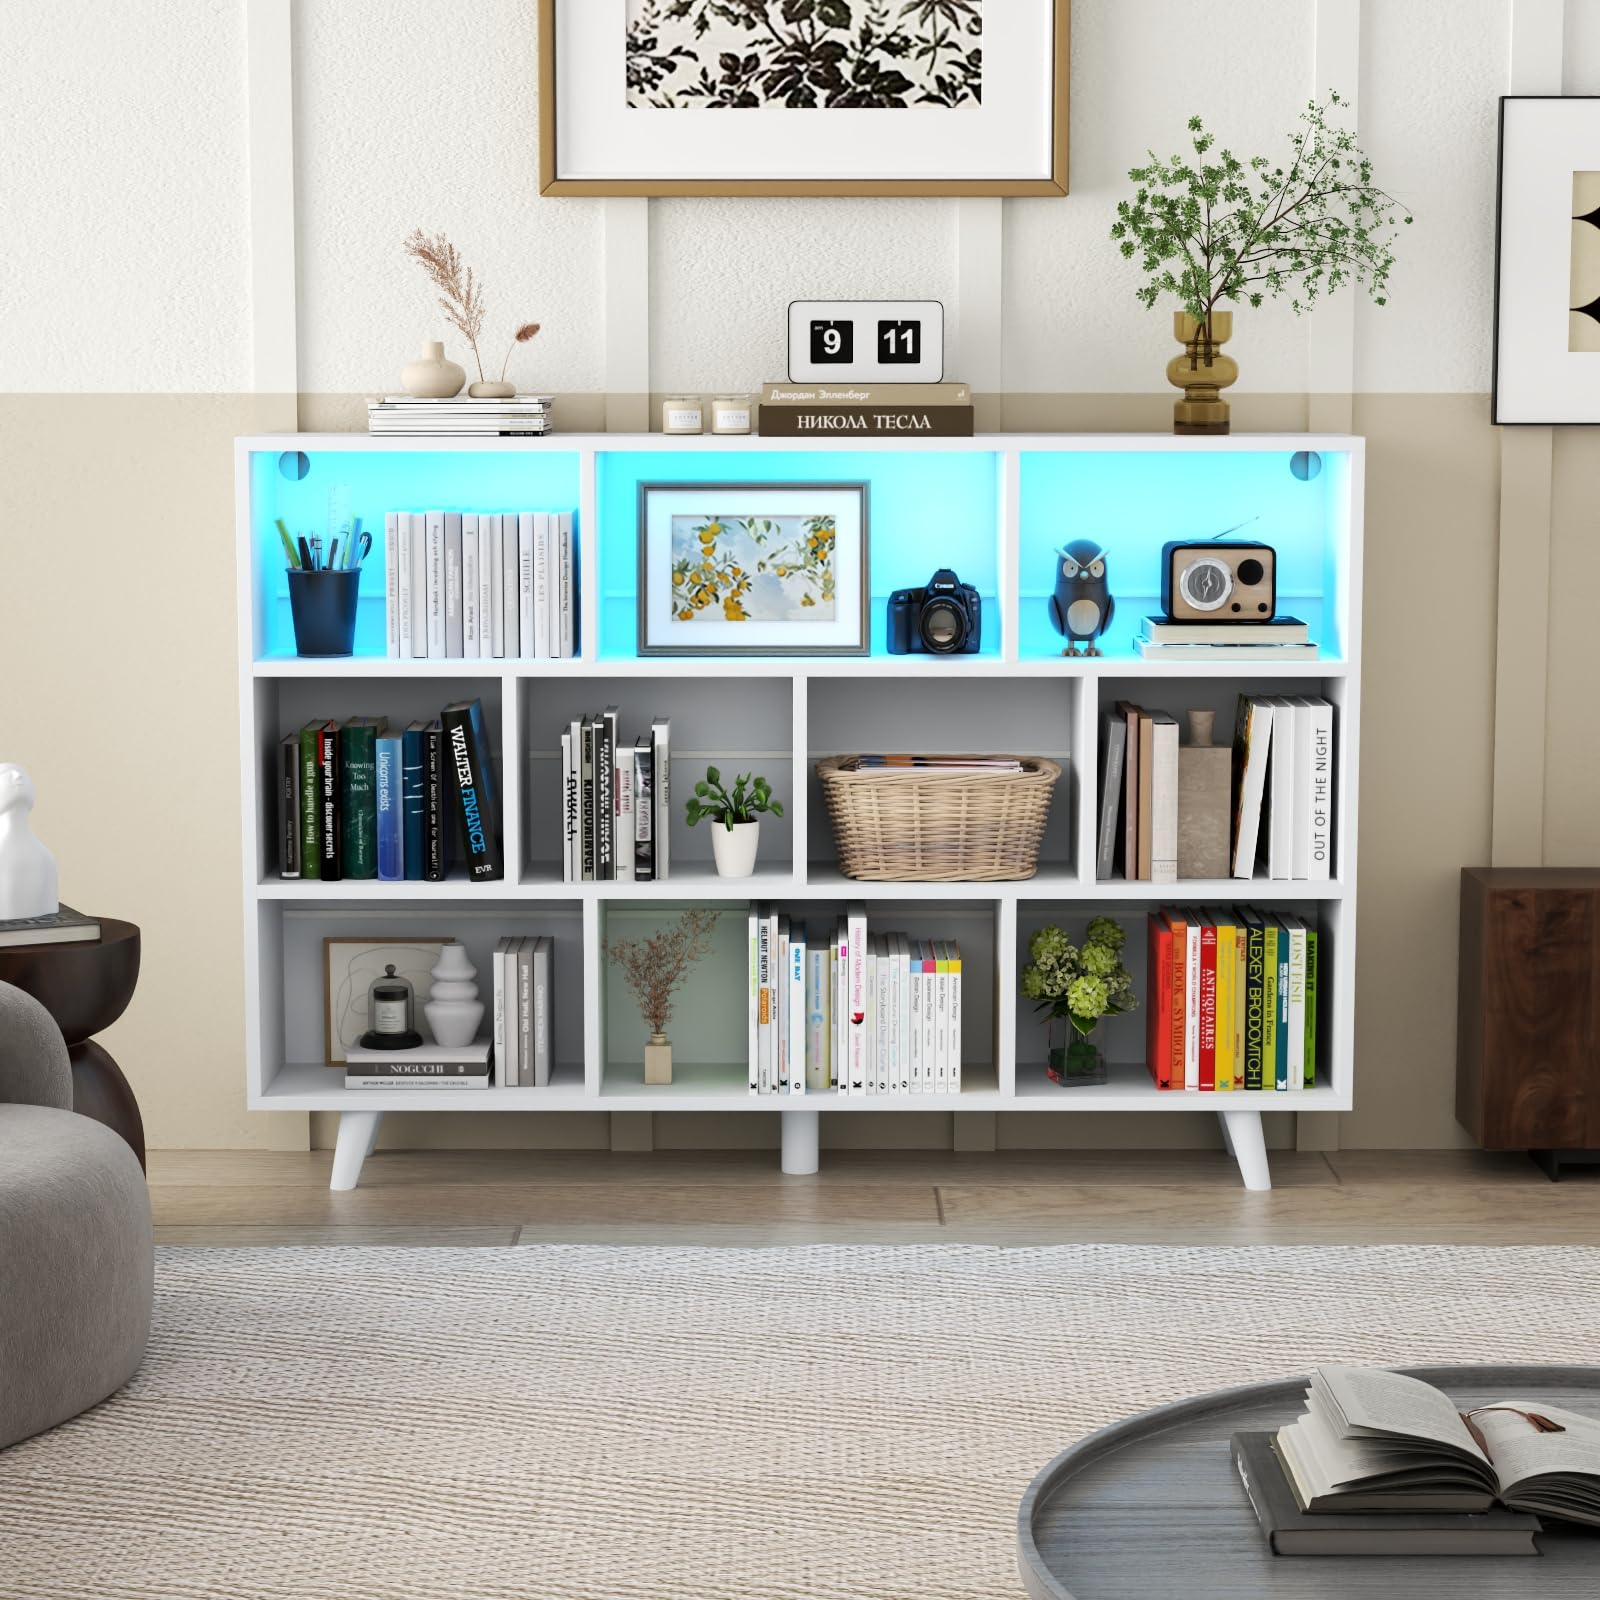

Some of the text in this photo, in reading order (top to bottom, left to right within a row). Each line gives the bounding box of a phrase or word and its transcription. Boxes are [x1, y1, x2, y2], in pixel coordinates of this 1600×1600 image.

[823, 329, 841, 354] 9
[884, 329, 913, 354] 11
[771, 390, 870, 400] Джордан Элленберг
[797, 415, 931, 429] НИКОЛА ТЕСЛА
[324, 738, 333, 760] Inside
[322, 761, 333, 777] your
[345, 762, 374, 770] Knowing
[353, 772, 366, 780] Too
[325, 778, 333, 796] brain
[350, 783, 369, 791] Much
[378, 752, 390, 811] Unicorns exists
[430, 783, 438, 800] Death
[450, 725, 486, 854] WALTER FINANCE
[306, 785, 314, 813] handle
[1314, 728, 1327, 861] OUT OF THE NIGHT
[306, 815, 314, 823] to
[325, 802, 334, 832] discover
[306, 825, 315, 844] How
[325, 833, 335, 859] secrets
[475, 864, 492, 874] EVR
[854, 928, 862, 949] History
[1291, 933, 1303, 1003] LOST FISH
[1306, 941, 1314, 979] MAKING
[1174, 962, 1184, 995] BOOK
[1307, 982, 1314, 991] IT
[854, 985, 862, 1006] Design
[1266, 977, 1274, 1008] Gardens
[879, 988, 887, 1024] Storyboard
[1205, 969, 1214, 1049] ANTIQUAIRES
[1248, 928, 1262, 1080] ALEXEY BRODOVITCH
[1267, 1010, 1273, 1018] in
[1173, 1008, 1183, 1067] SYMBOLS
[390, 1065, 444, 1073] NOGUCHI
